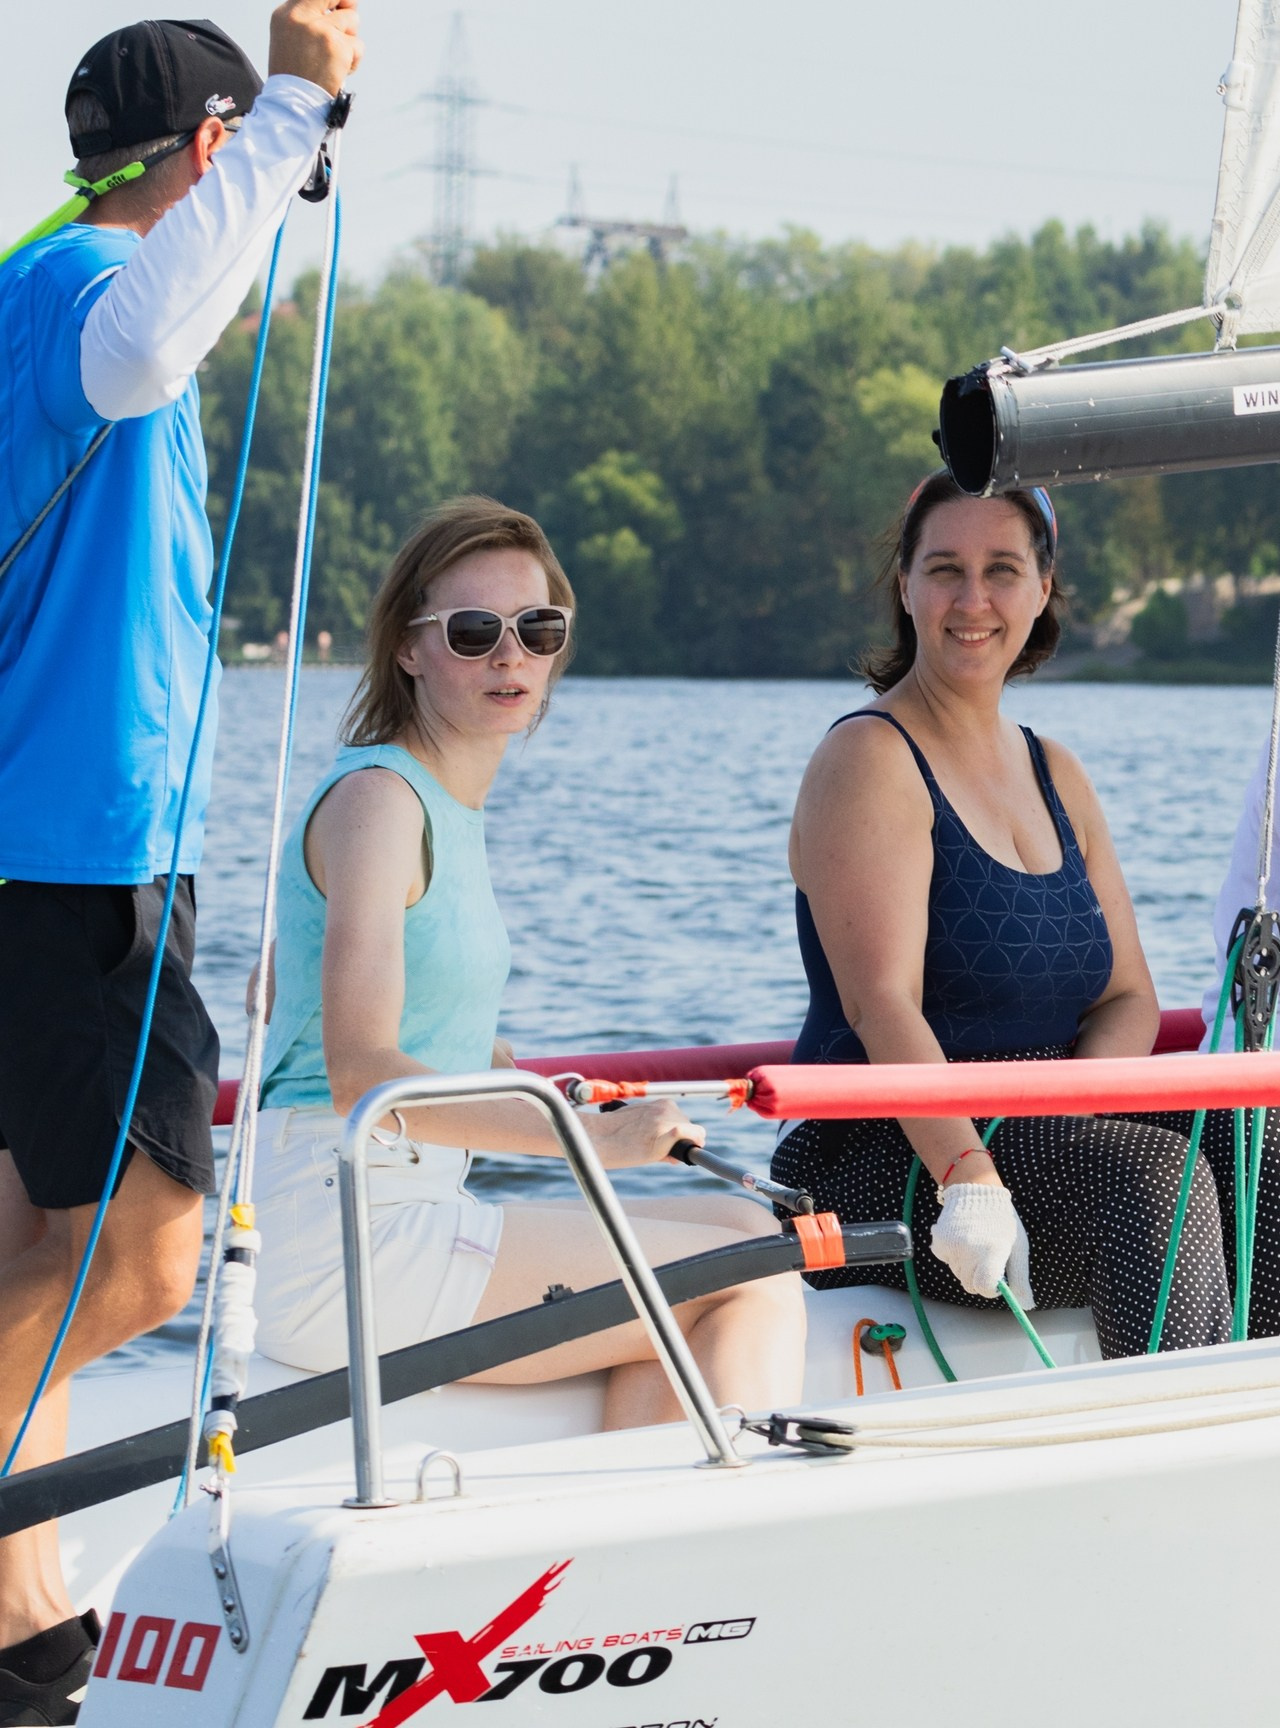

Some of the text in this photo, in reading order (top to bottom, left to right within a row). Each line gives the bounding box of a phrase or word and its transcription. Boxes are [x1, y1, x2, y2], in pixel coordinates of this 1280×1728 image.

[92, 1611, 222, 1692] 100
[500, 1618, 755, 1659] SAILING BOATS MG
